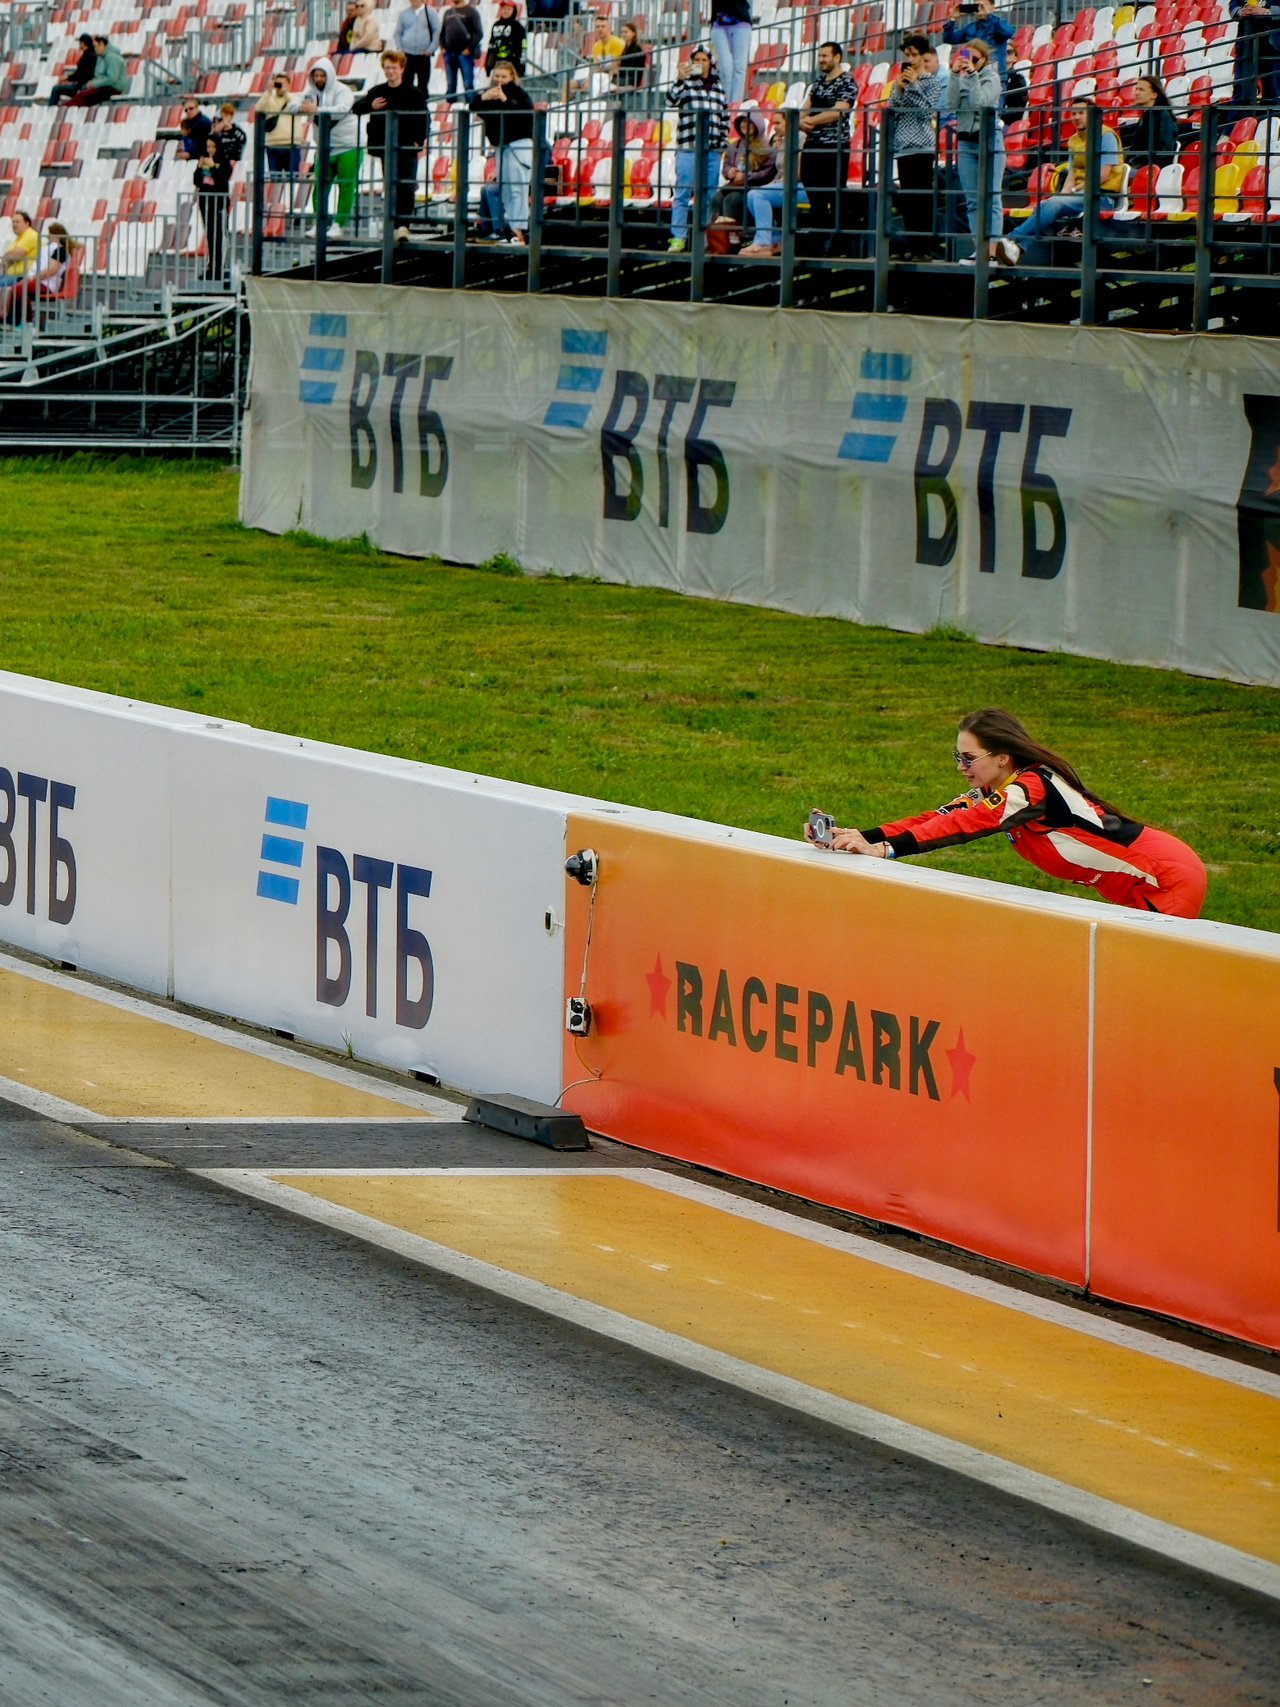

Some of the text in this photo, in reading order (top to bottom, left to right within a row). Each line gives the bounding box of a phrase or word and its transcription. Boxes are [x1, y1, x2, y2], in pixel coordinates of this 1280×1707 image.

[349, 350, 454, 498] ВТБ
[601, 370, 736, 535] ВТБ
[914, 397, 1073, 580] ВТБ
[317, 846, 434, 1029] ВТБ
[675, 960, 941, 1101] RACEPARK
